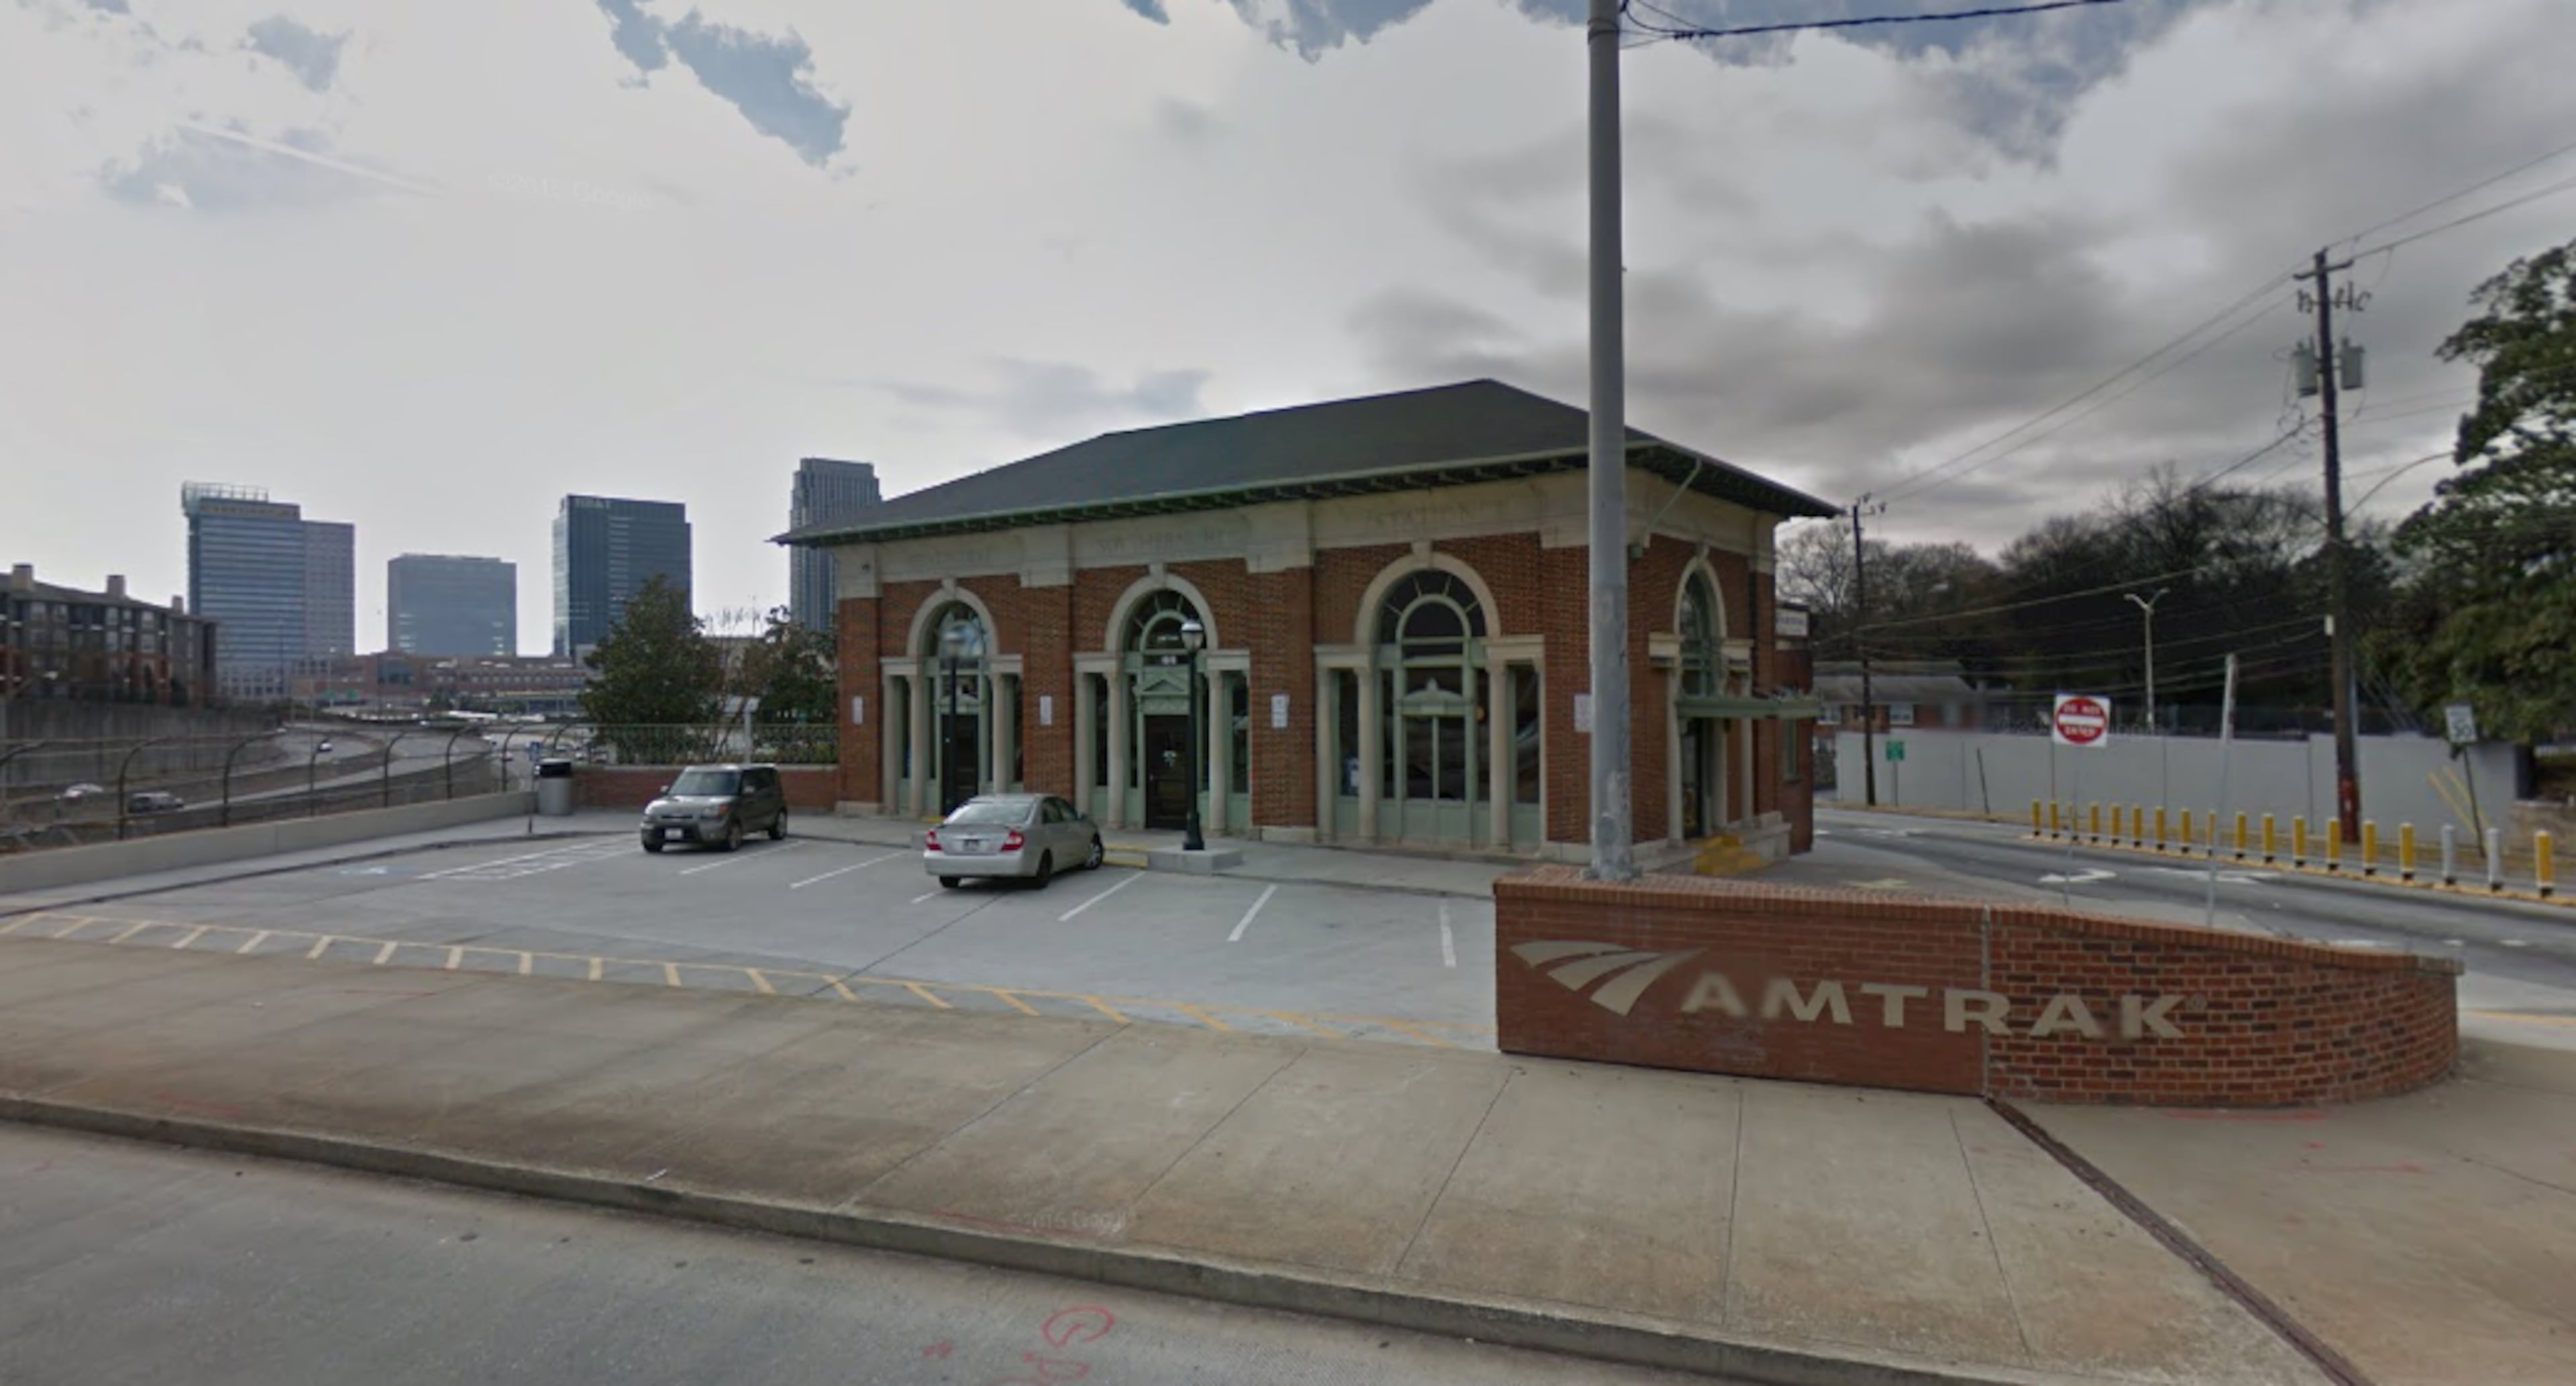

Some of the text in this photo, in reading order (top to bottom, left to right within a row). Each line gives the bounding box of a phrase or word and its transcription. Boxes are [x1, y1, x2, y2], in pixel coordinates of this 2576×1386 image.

[2063, 703, 2101, 715] DO NOT
[2063, 725, 2096, 737] ENTER
[1679, 972, 2188, 1039] AMTRAK
